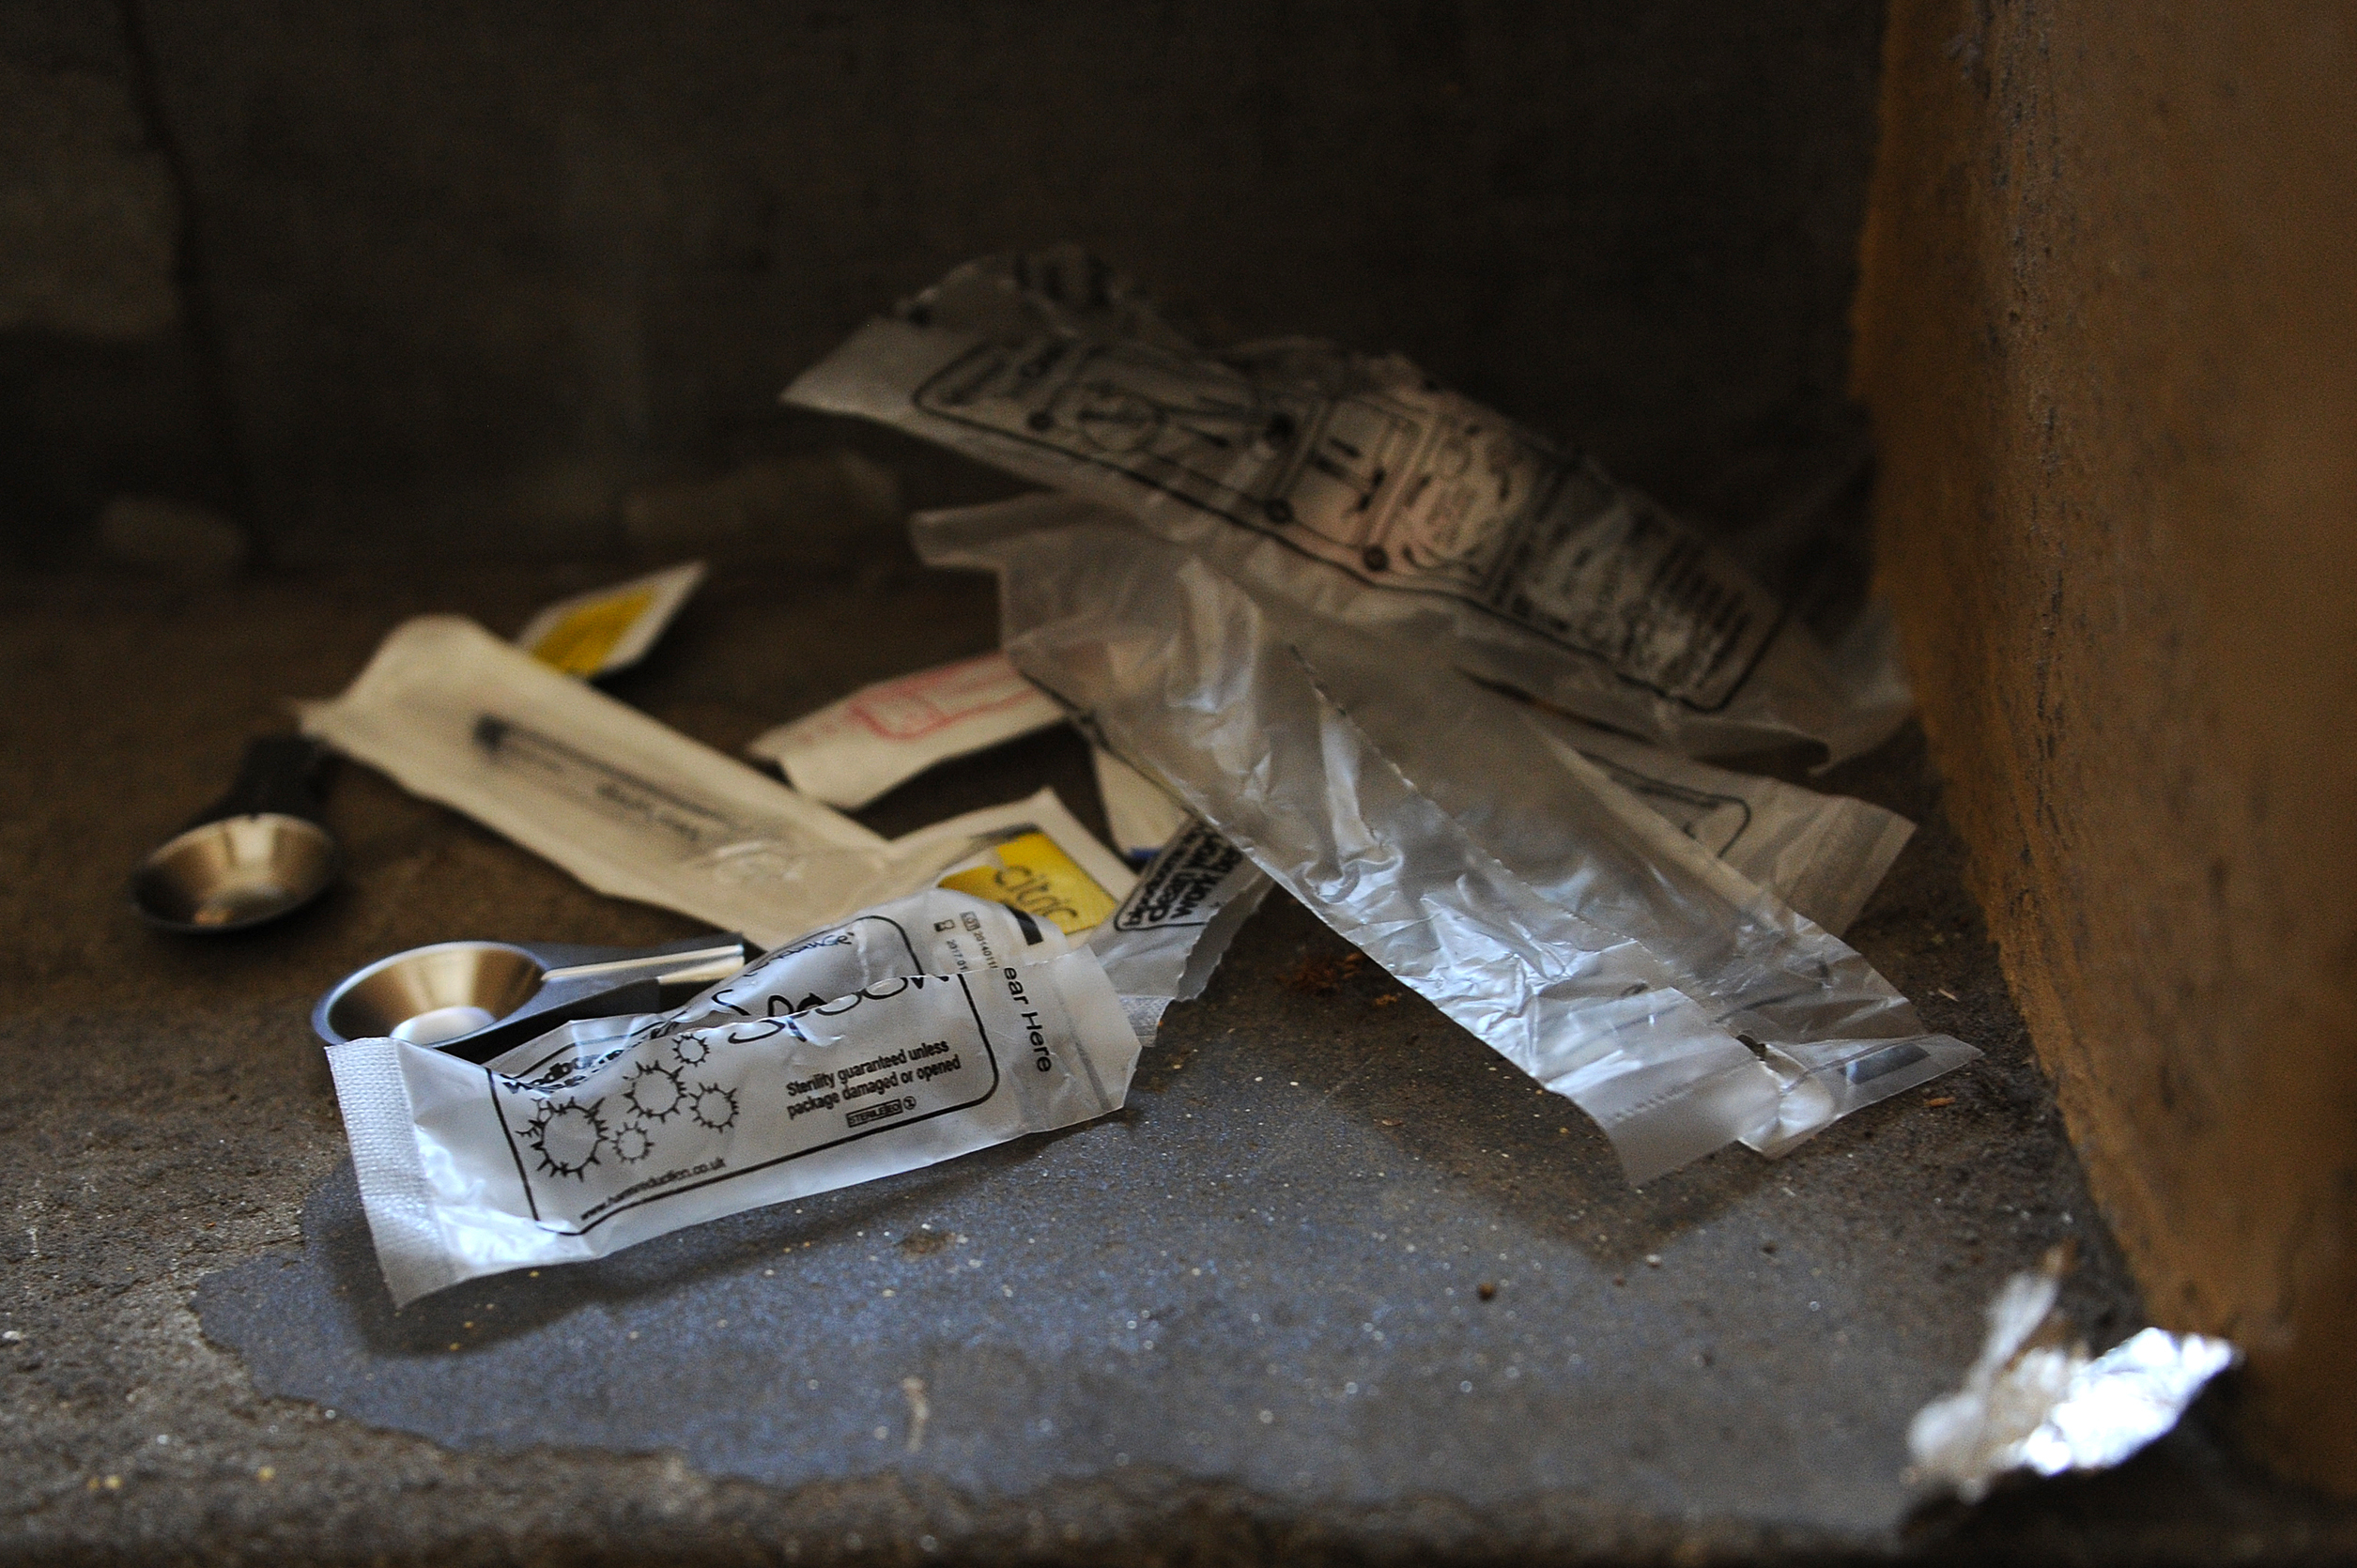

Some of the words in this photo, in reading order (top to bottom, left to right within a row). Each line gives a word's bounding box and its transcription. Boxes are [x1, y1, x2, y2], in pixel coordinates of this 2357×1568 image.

[1003, 967, 1029, 1006] ear
[1021, 1011, 1053, 1072] Here
[786, 1072, 836, 1097] Sterility
[838, 1049, 907, 1084] guaranteed
[908, 1040, 950, 1061] unless
[787, 1091, 840, 1119] package
[842, 1071, 899, 1100] damaged
[901, 1069, 914, 1084] or
[917, 1054, 962, 1082] opened
